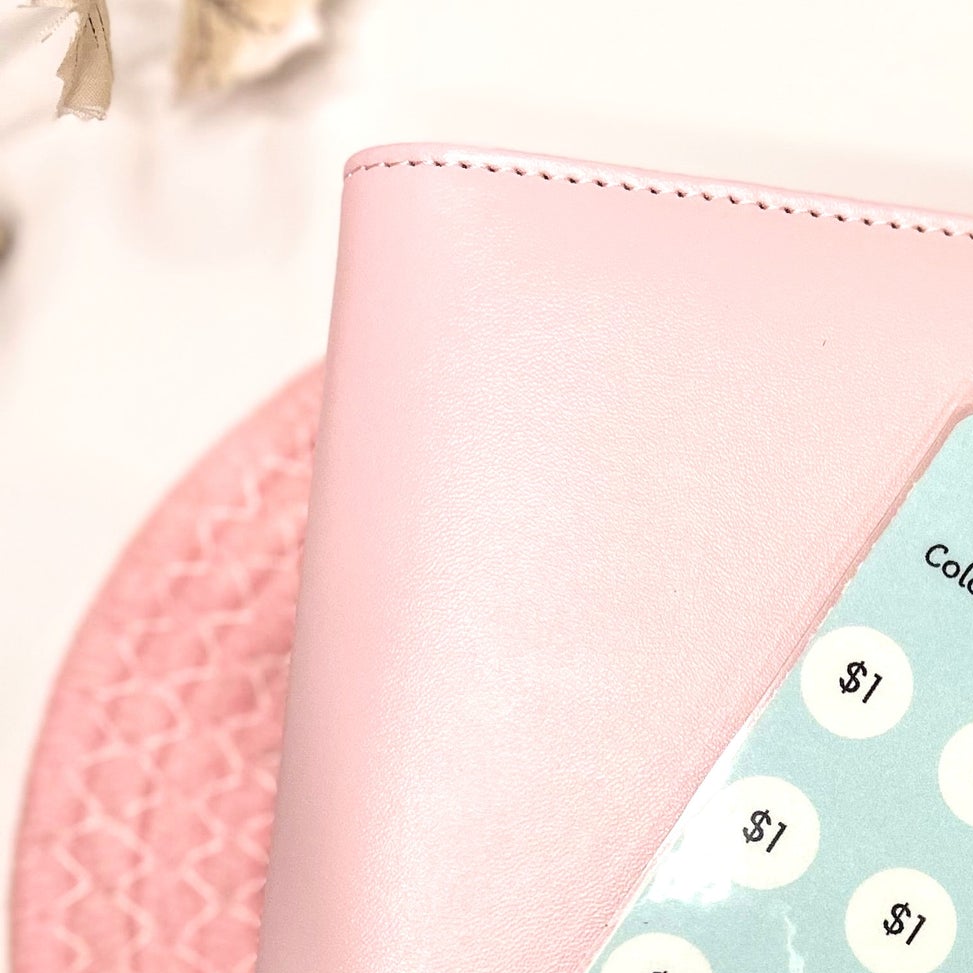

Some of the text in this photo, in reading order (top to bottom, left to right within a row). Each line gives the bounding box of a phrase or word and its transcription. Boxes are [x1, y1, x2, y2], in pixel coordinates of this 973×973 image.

[838, 660, 883, 704] $1
[742, 809, 788, 853] $1
[882, 902, 927, 946] $1
